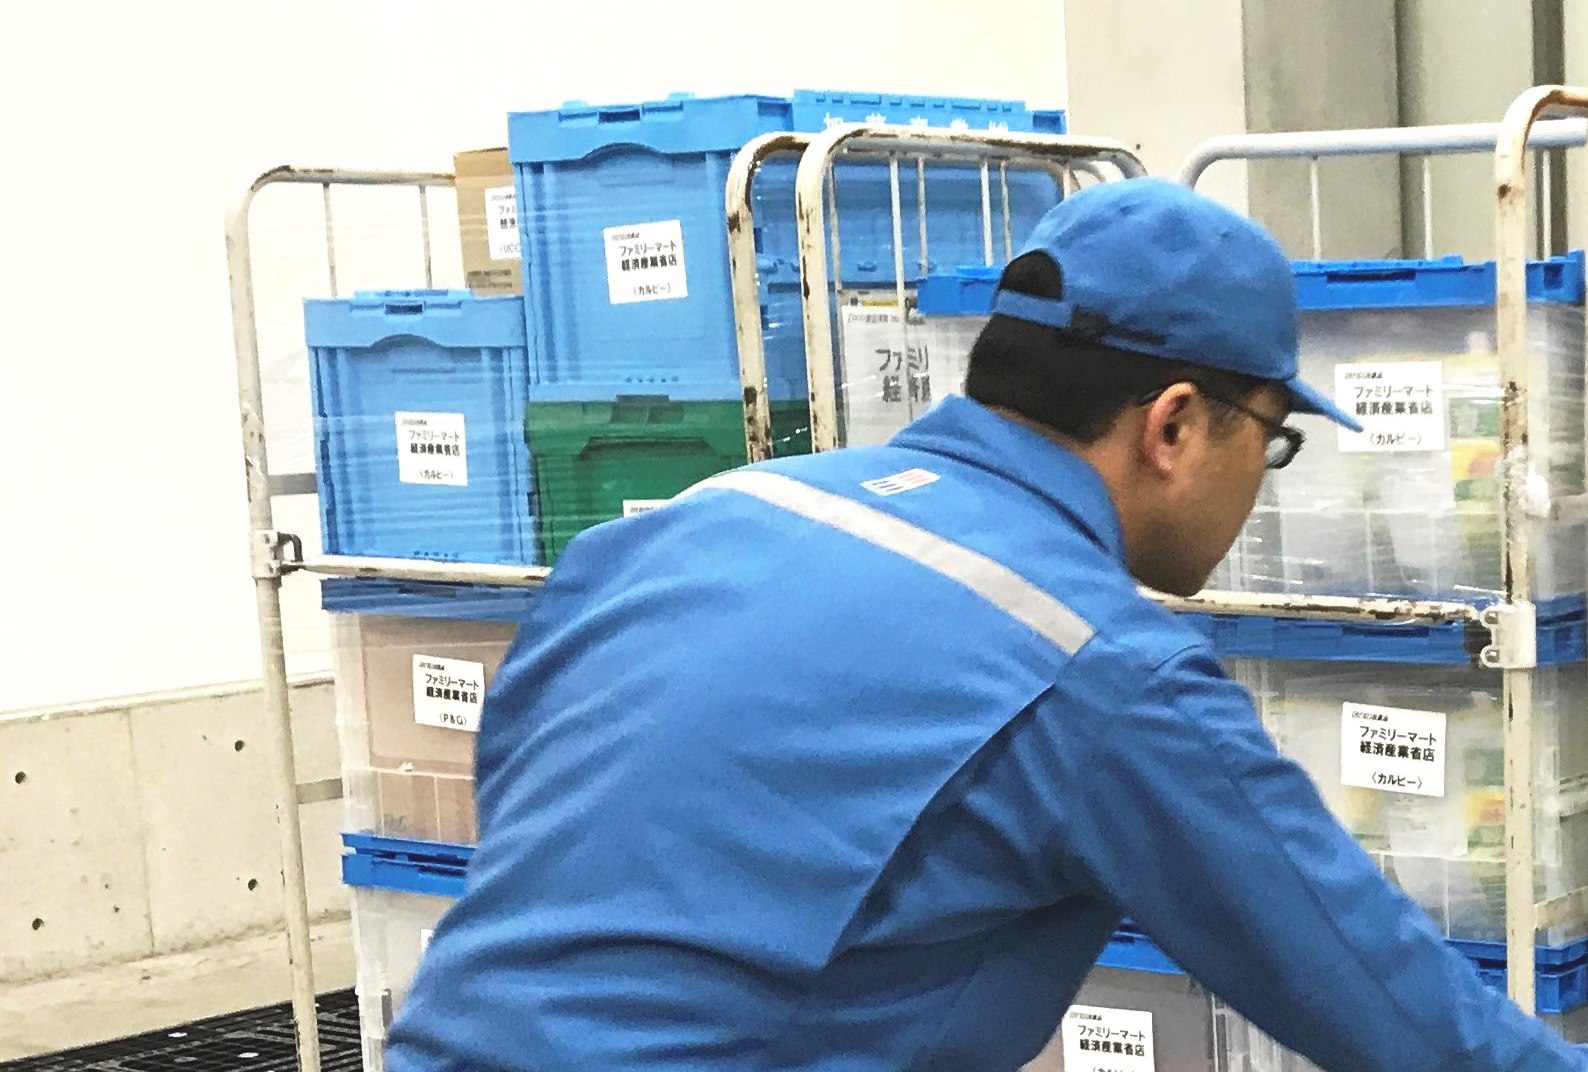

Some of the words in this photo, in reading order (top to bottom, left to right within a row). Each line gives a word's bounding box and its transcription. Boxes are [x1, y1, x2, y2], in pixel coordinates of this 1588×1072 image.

[619, 240, 677, 257] ファミリーマート
[1354, 384, 1434, 399] ファミリーマート
[425, 673, 479, 691] ファミリーマート
[1359, 725, 1437, 746] ファミリーマート
[1359, 740, 1435, 762] 経済産業省店
[1078, 1024, 1146, 1042] ファミリーマート
